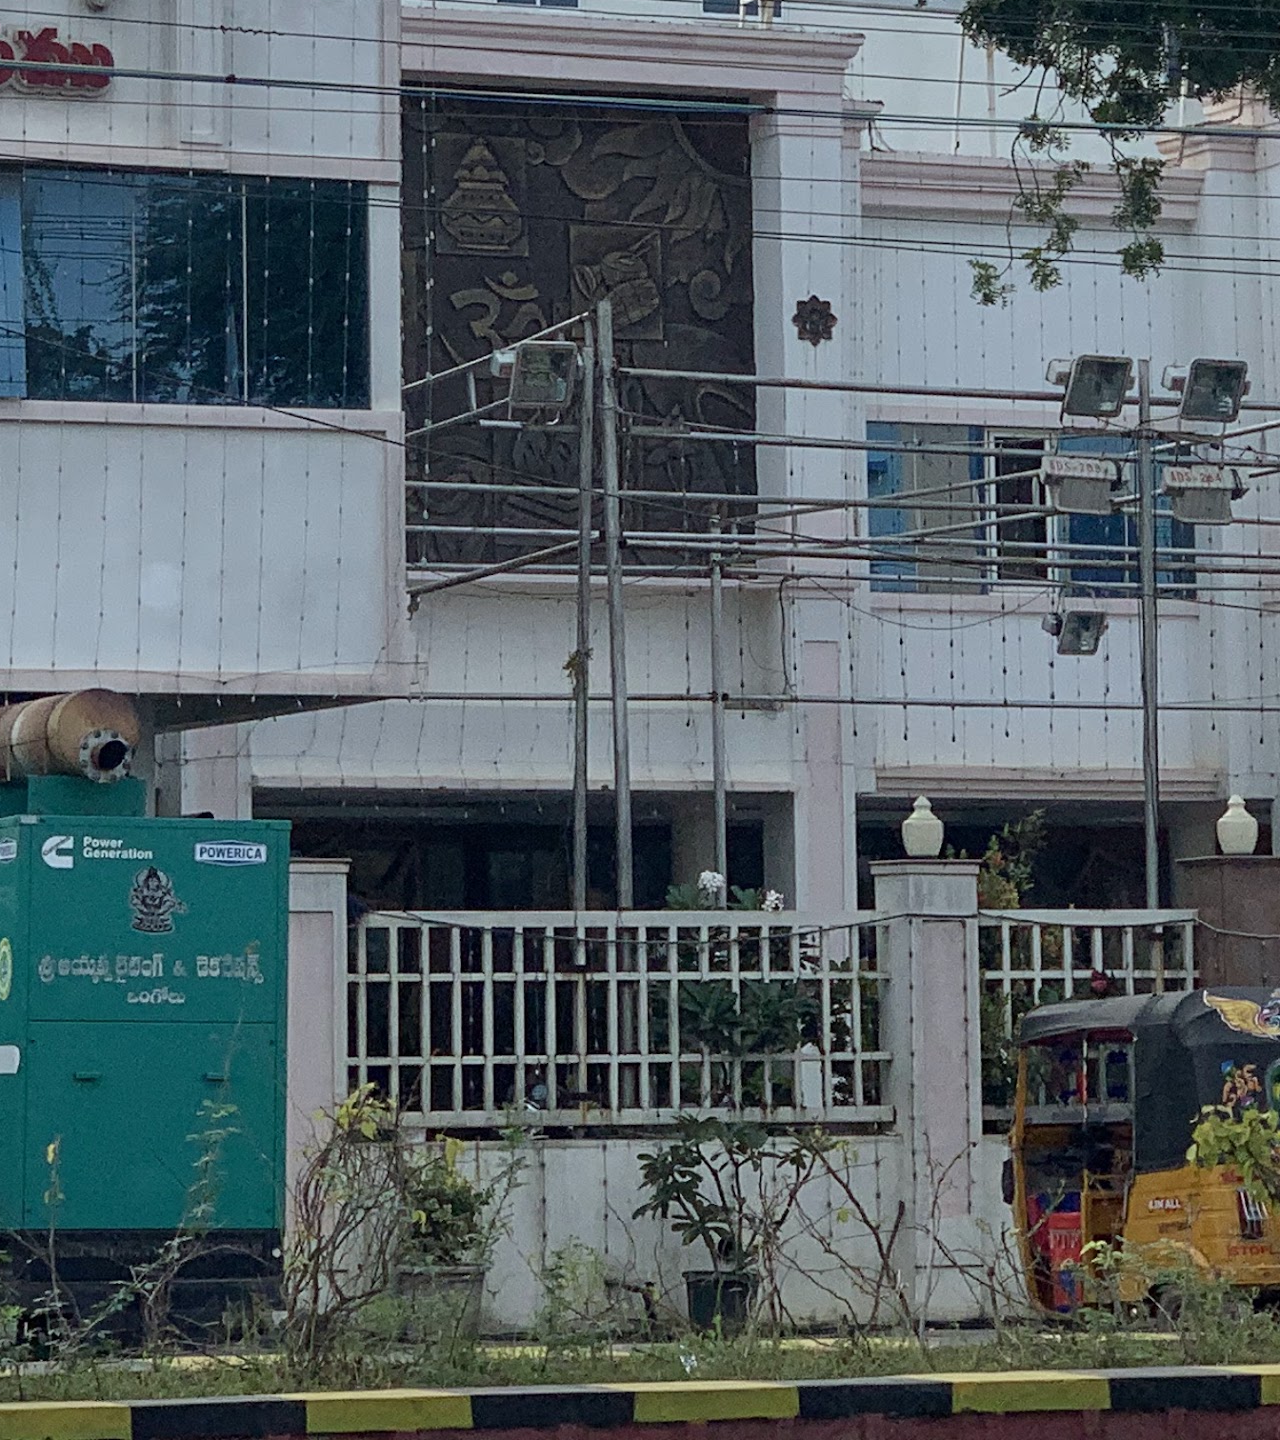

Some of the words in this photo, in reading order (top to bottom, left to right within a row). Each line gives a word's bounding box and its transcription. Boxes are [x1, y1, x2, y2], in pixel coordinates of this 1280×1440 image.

[83, 836, 123, 848] Power
[83, 847, 154, 860] Generation
[198, 846, 264, 859] POWERICA
